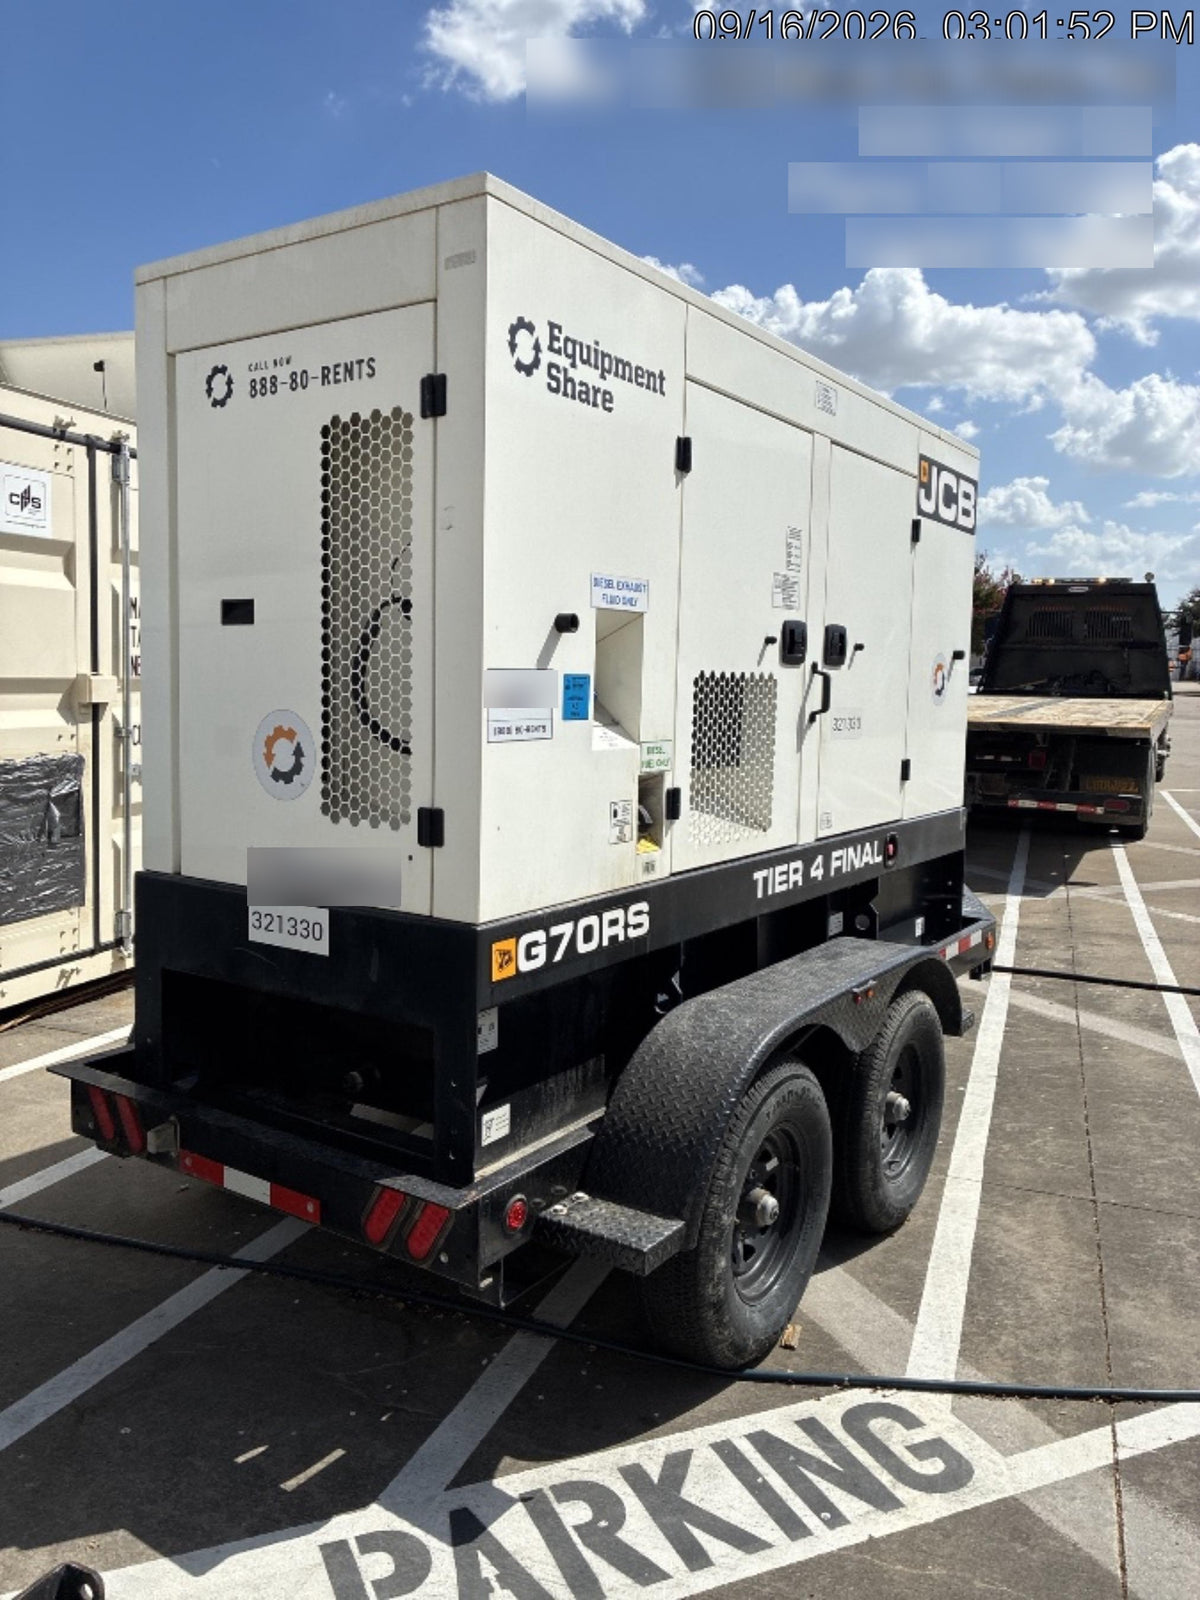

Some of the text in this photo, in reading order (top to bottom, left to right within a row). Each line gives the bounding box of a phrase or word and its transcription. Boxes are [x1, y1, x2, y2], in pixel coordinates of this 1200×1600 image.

[248, 355, 292, 372] CALL NOW
[249, 357, 376, 399] 888-80-RENTS
[546, 319, 666, 397] Equipment
[546, 360, 615, 413] Share
[918, 464, 976, 529] JCB
[752, 839, 884, 899] TIER 4 FINAL
[251, 910, 323, 941] 321330
[516, 900, 651, 973] G70RS
[317, 1400, 976, 1600] PARKING
